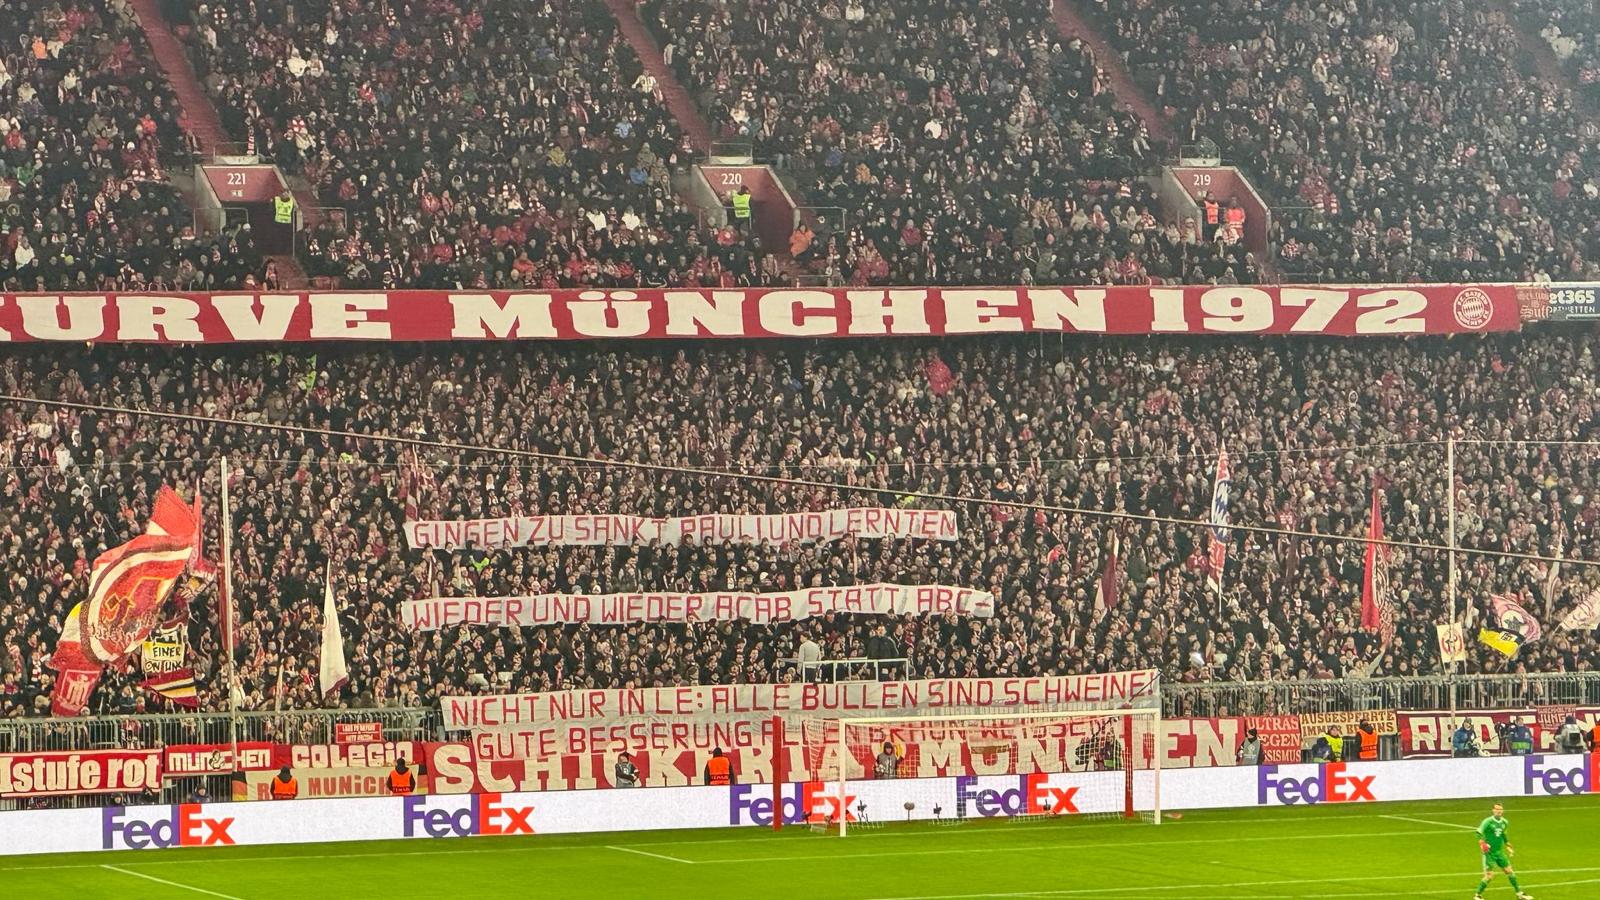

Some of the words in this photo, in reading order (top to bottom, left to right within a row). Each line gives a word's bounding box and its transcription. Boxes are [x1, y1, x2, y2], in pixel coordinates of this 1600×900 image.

[227, 173, 246, 185] 221
[721, 173, 742, 185] 220
[1193, 174, 1211, 186] 219
[0, 293, 392, 341] URVE
[449, 288, 1107, 338] MÜNCHEN
[1150, 287, 1428, 334] 1972
[1548, 289, 1596, 305] et365
[414, 517, 520, 548] GINGEN
[529, 515, 564, 541] ZU
[575, 514, 667, 543] SANKT
[680, 515, 762, 540] PAULI
[769, 514, 822, 540] UND
[829, 508, 956, 536] LERNTEN
[413, 599, 523, 630] WIEDER
[532, 595, 591, 624] UND
[601, 594, 702, 622] WIEDER
[716, 594, 792, 622] ACAB
[808, 586, 900, 615] STATT
[153, 646, 181, 658] EINER
[451, 695, 540, 727] NICHT
[549, 690, 606, 721] NUR
[619, 688, 645, 717] IN
[656, 687, 703, 715] LE:
[712, 683, 790, 714] ALLE
[801, 683, 918, 710] BULLEN
[928, 680, 994, 708] SIND
[1004, 671, 1155, 706] SCHWEINE!
[1246, 716, 1299, 731] ULTRAS
[1302, 710, 1394, 724] AUSGESPERRTE
[1303, 724, 1342, 737] IMMR
[477, 728, 557, 761] GUTE
[569, 720, 751, 755] BESSERUNG
[1258, 733, 1301, 747] EGEN
[1263, 749, 1302, 762] SISMUS
[107, 754, 159, 789] rot
[1258, 763, 1376, 805] FedEx
[730, 784, 857, 827] FedEx
[957, 774, 1080, 817] FedEx
[102, 804, 235, 849] FedEx
[404, 796, 535, 838] FedEx
